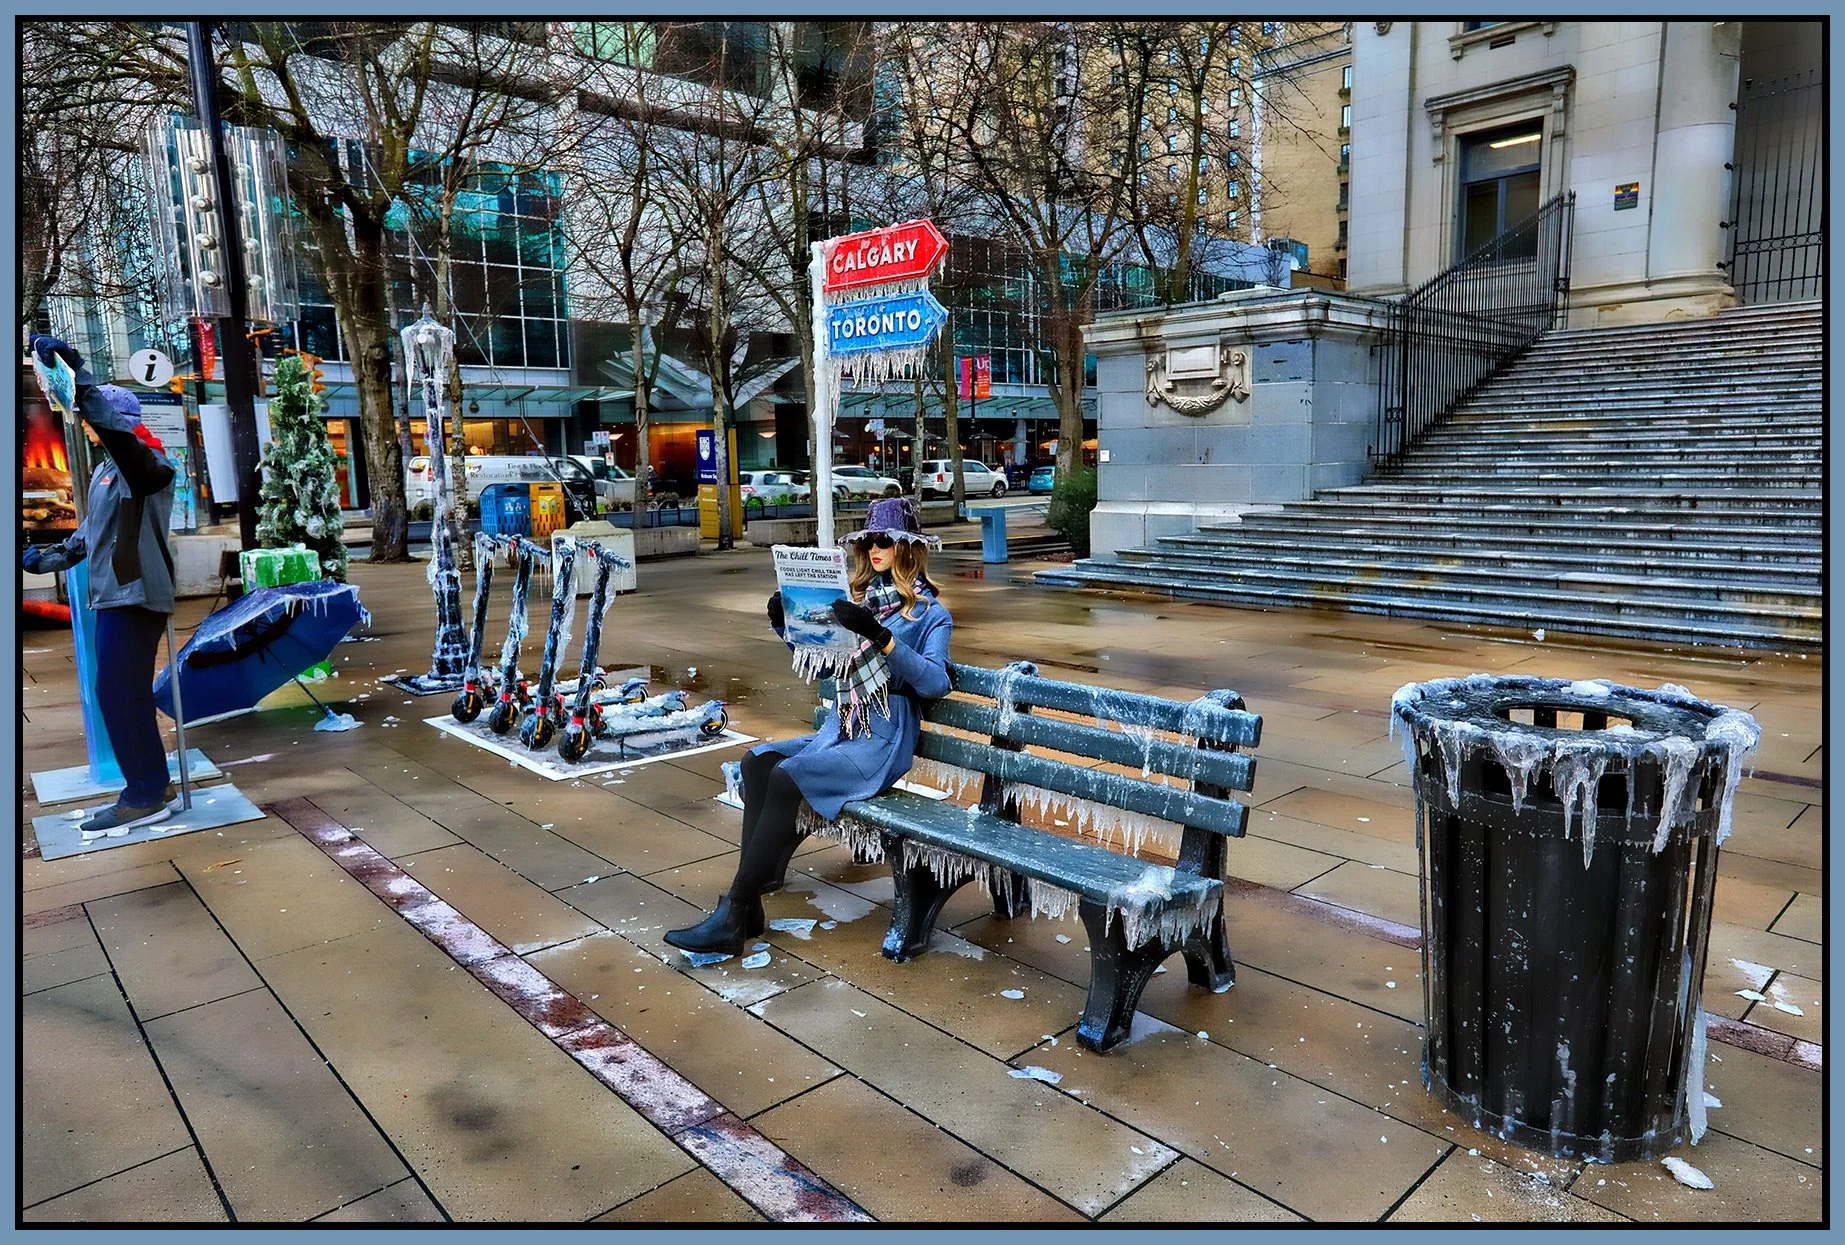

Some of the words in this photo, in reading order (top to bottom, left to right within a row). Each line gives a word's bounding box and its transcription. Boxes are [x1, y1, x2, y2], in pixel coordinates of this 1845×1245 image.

[833, 240, 918, 273] CALGARY
[831, 309, 921, 340] TORONTO
[775, 550, 788, 560] The
[790, 551, 809, 561] Chill
[810, 552, 832, 561] Times
